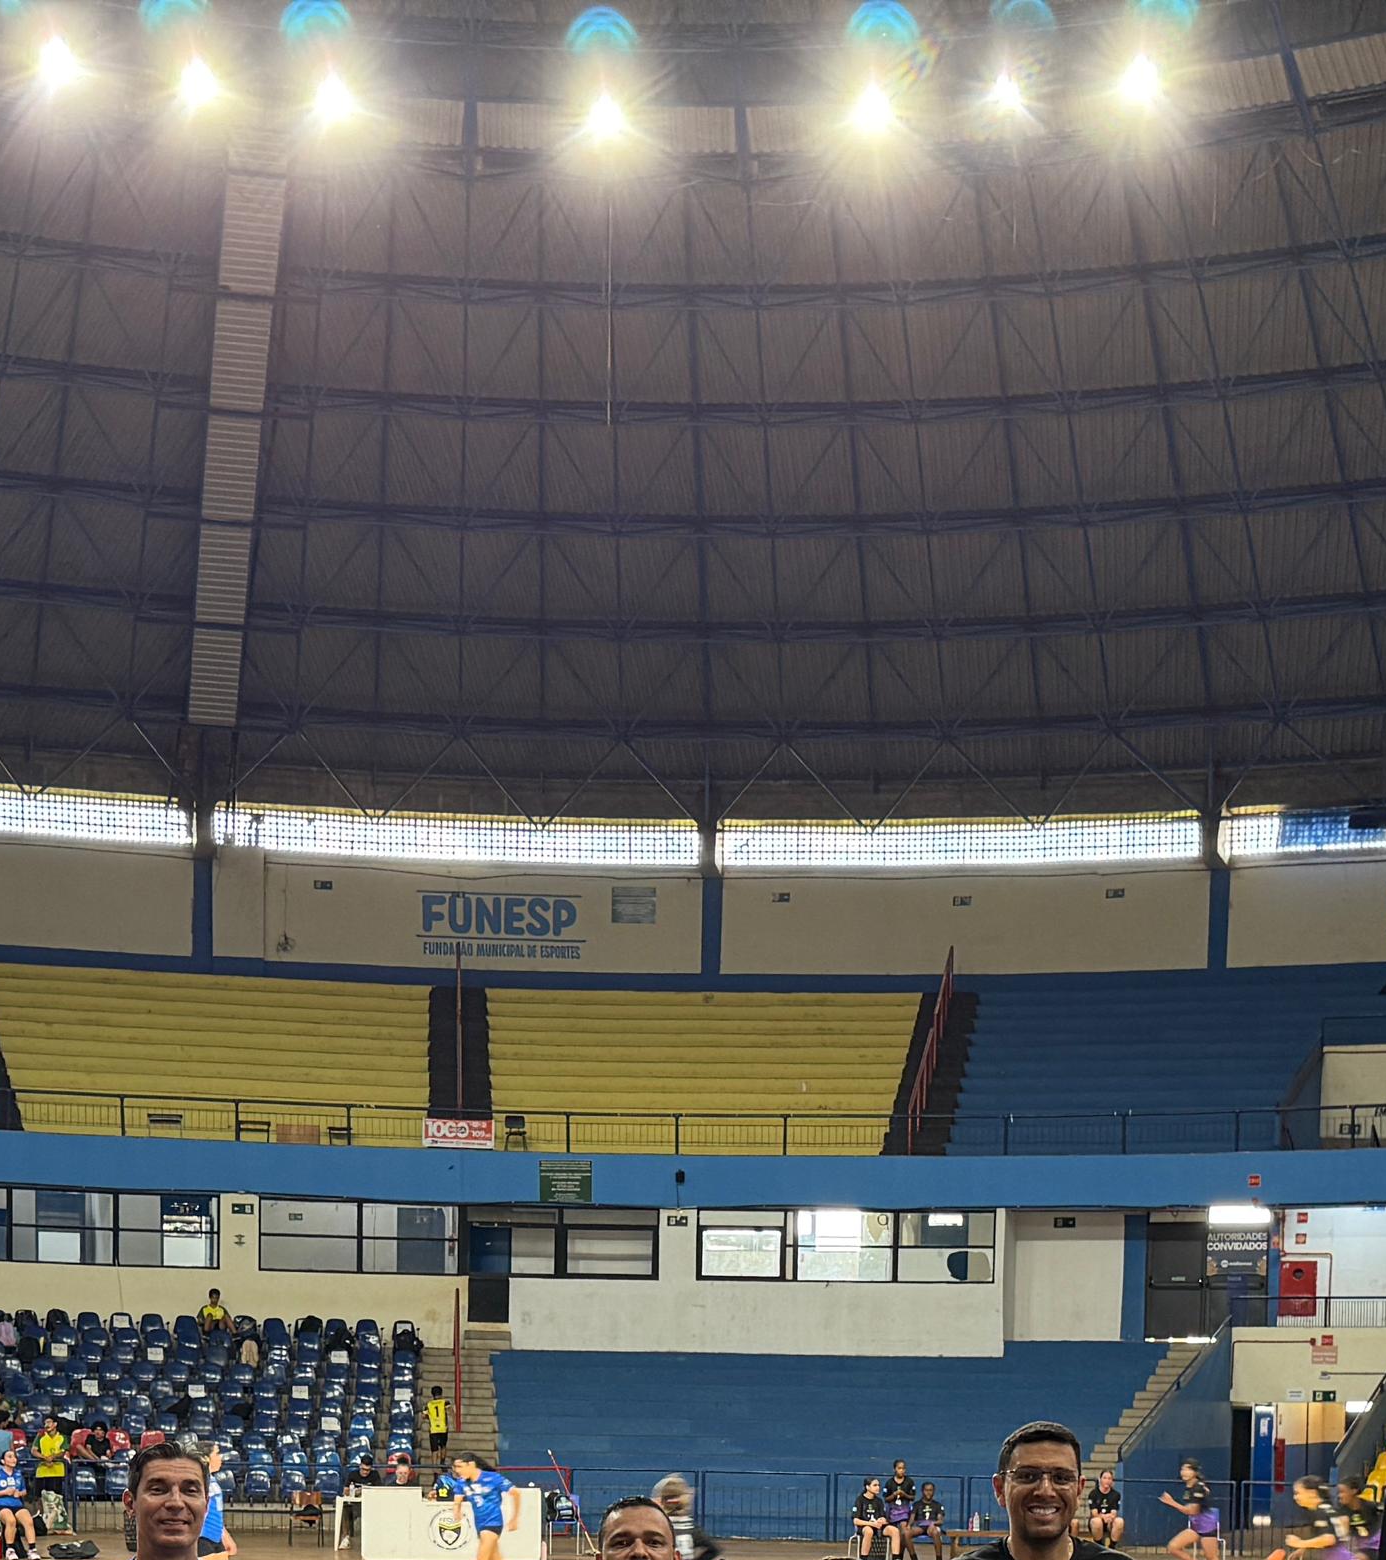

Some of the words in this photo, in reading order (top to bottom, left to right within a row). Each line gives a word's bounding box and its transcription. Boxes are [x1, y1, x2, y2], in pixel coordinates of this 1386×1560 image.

[421, 894, 578, 937] FUNESP
[476, 943, 525, 958] MUNICIPAL
[527, 944, 537, 958] DE
[540, 945, 581, 960] ESPORTES
[1207, 1232, 1268, 1241] AUTORIDADES
[1206, 1241, 1268, 1251] CONVIDADOS
